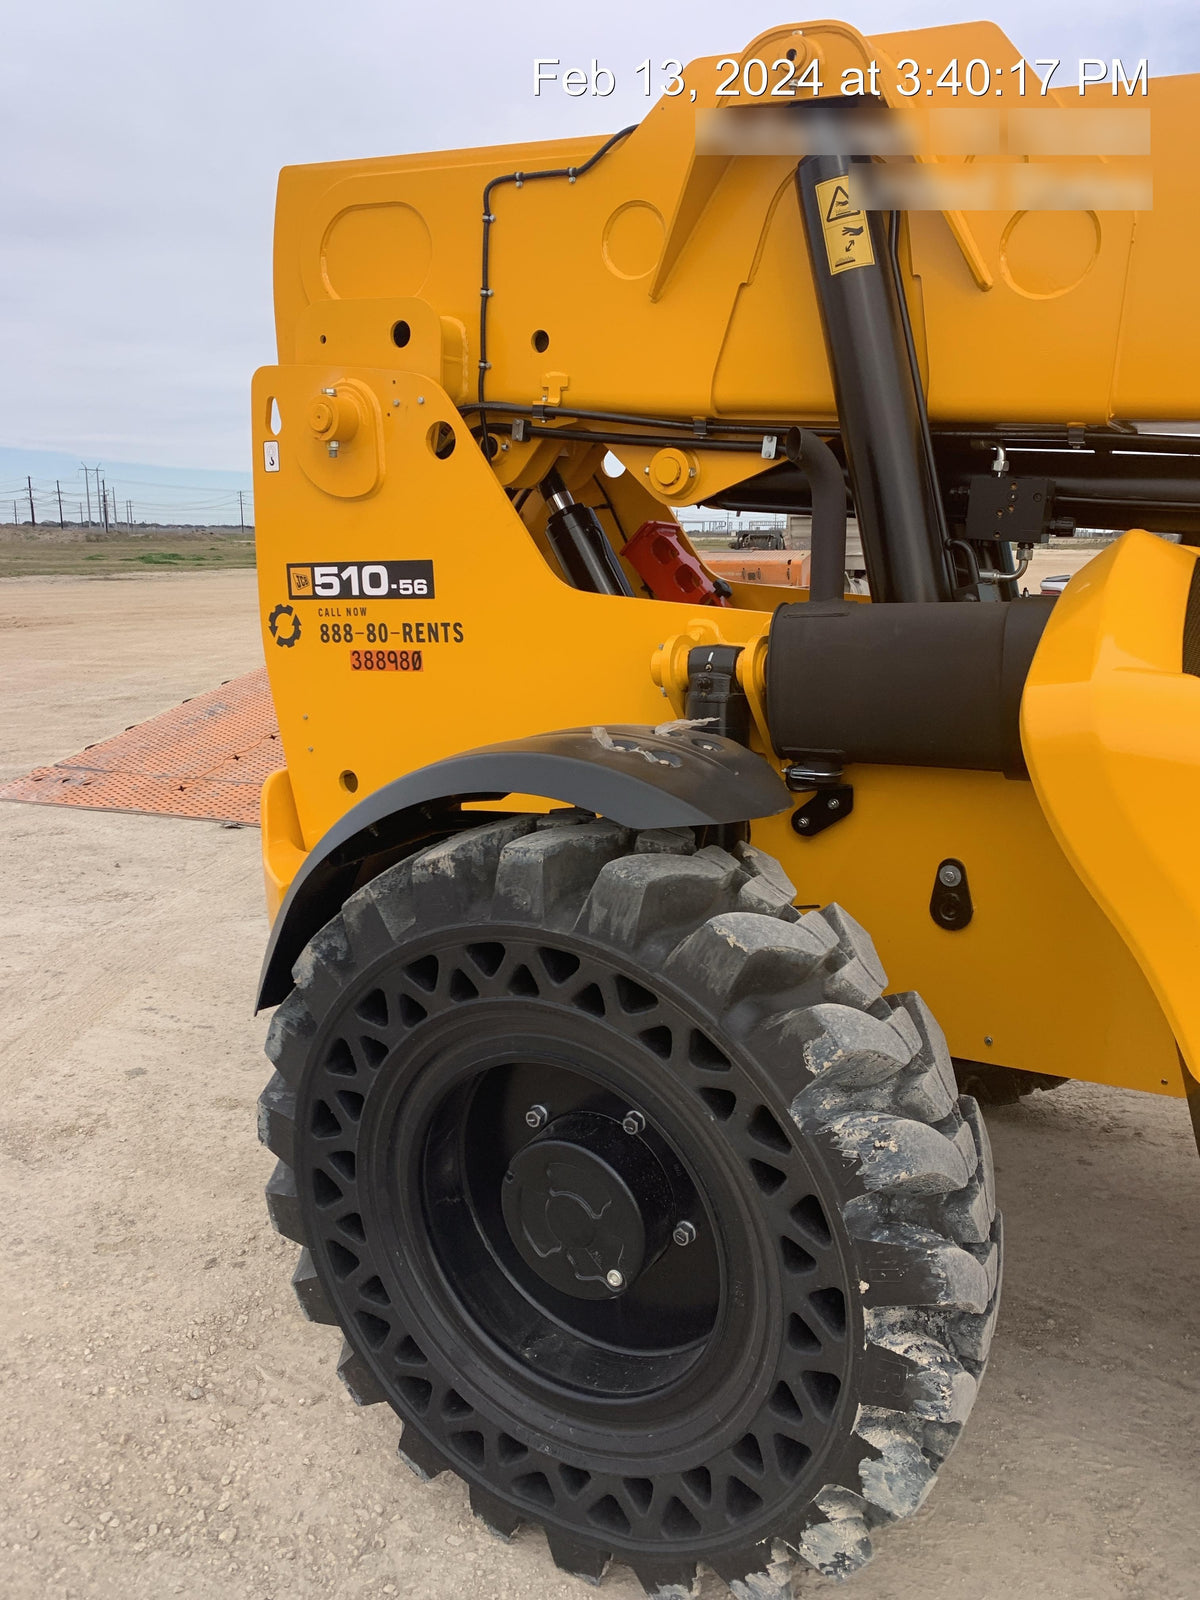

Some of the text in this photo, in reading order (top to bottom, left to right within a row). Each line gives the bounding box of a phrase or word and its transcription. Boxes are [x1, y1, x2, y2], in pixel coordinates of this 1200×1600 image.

[318, 607, 367, 617] CALL NOW
[320, 622, 464, 643] 888-80-RENTS
[351, 650, 422, 670] 388980
